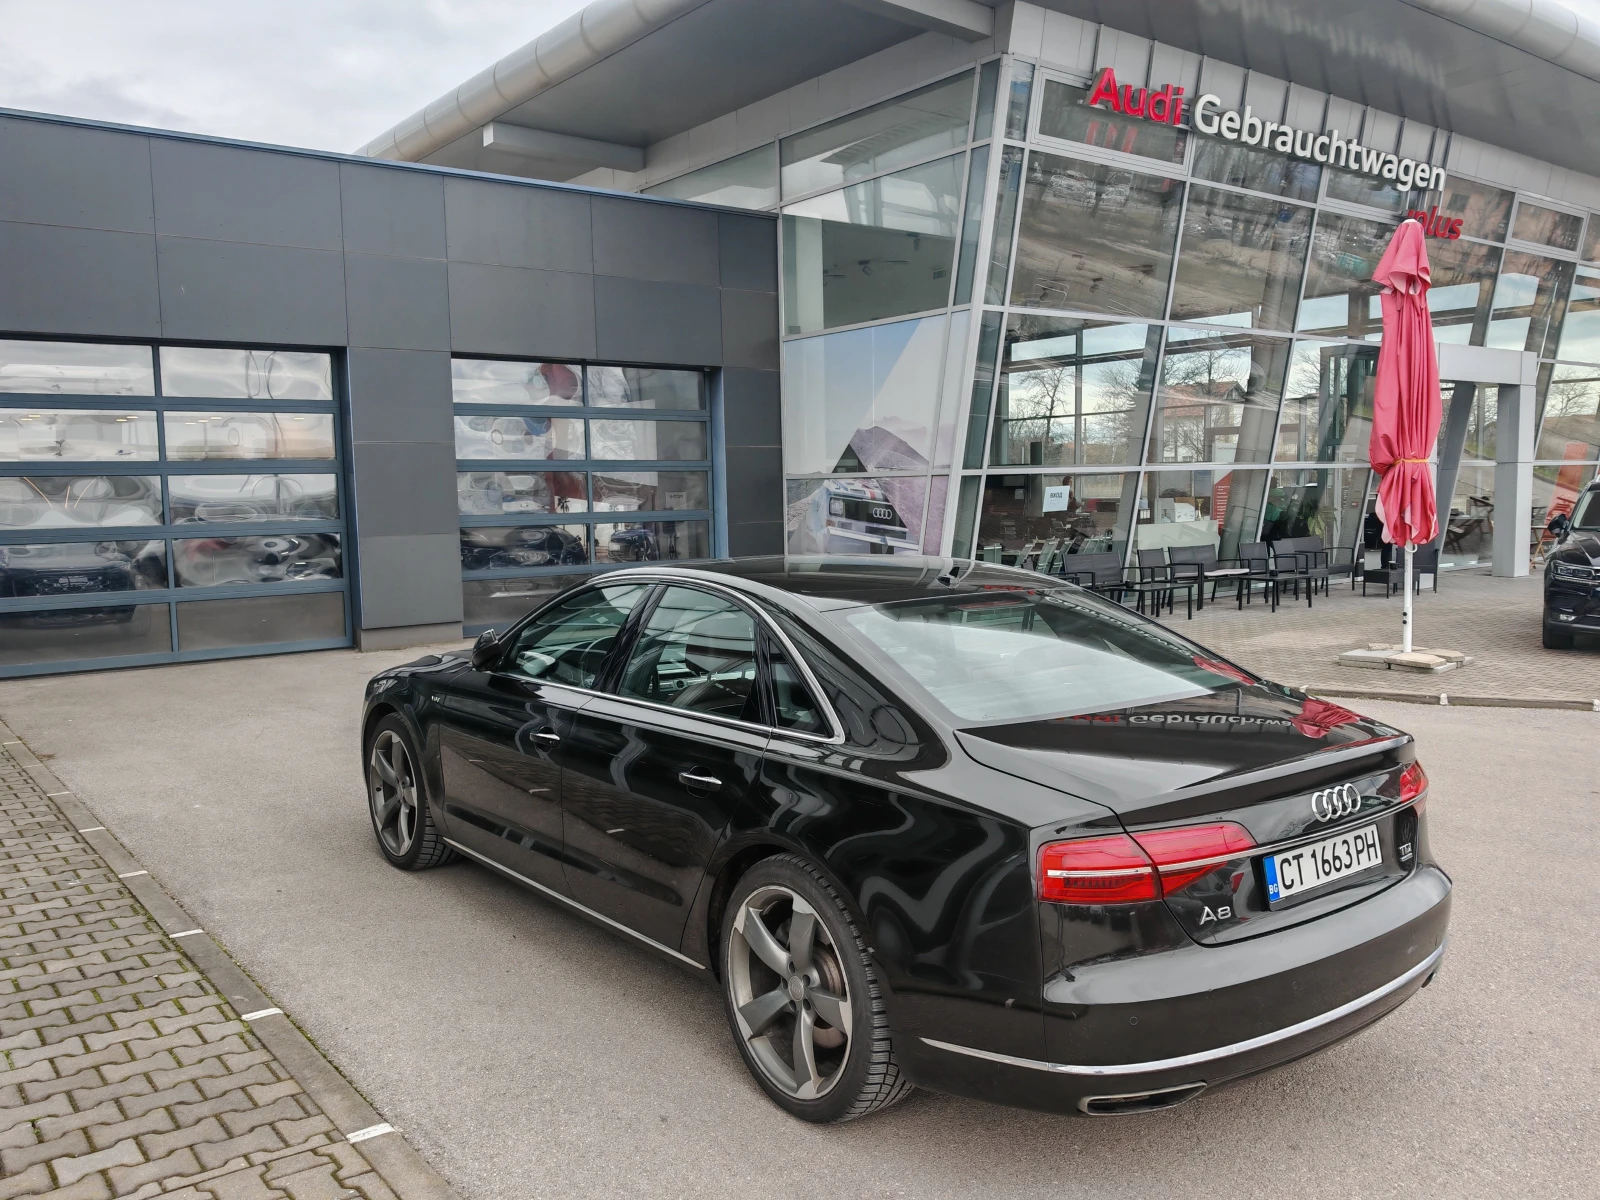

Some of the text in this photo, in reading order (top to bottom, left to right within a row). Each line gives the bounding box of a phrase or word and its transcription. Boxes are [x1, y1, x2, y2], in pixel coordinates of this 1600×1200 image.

[1088, 67, 1446, 193] Audi Gebrauchtwagen
[1268, 883, 1279, 895] BG
[1200, 905, 1232, 925] A8
